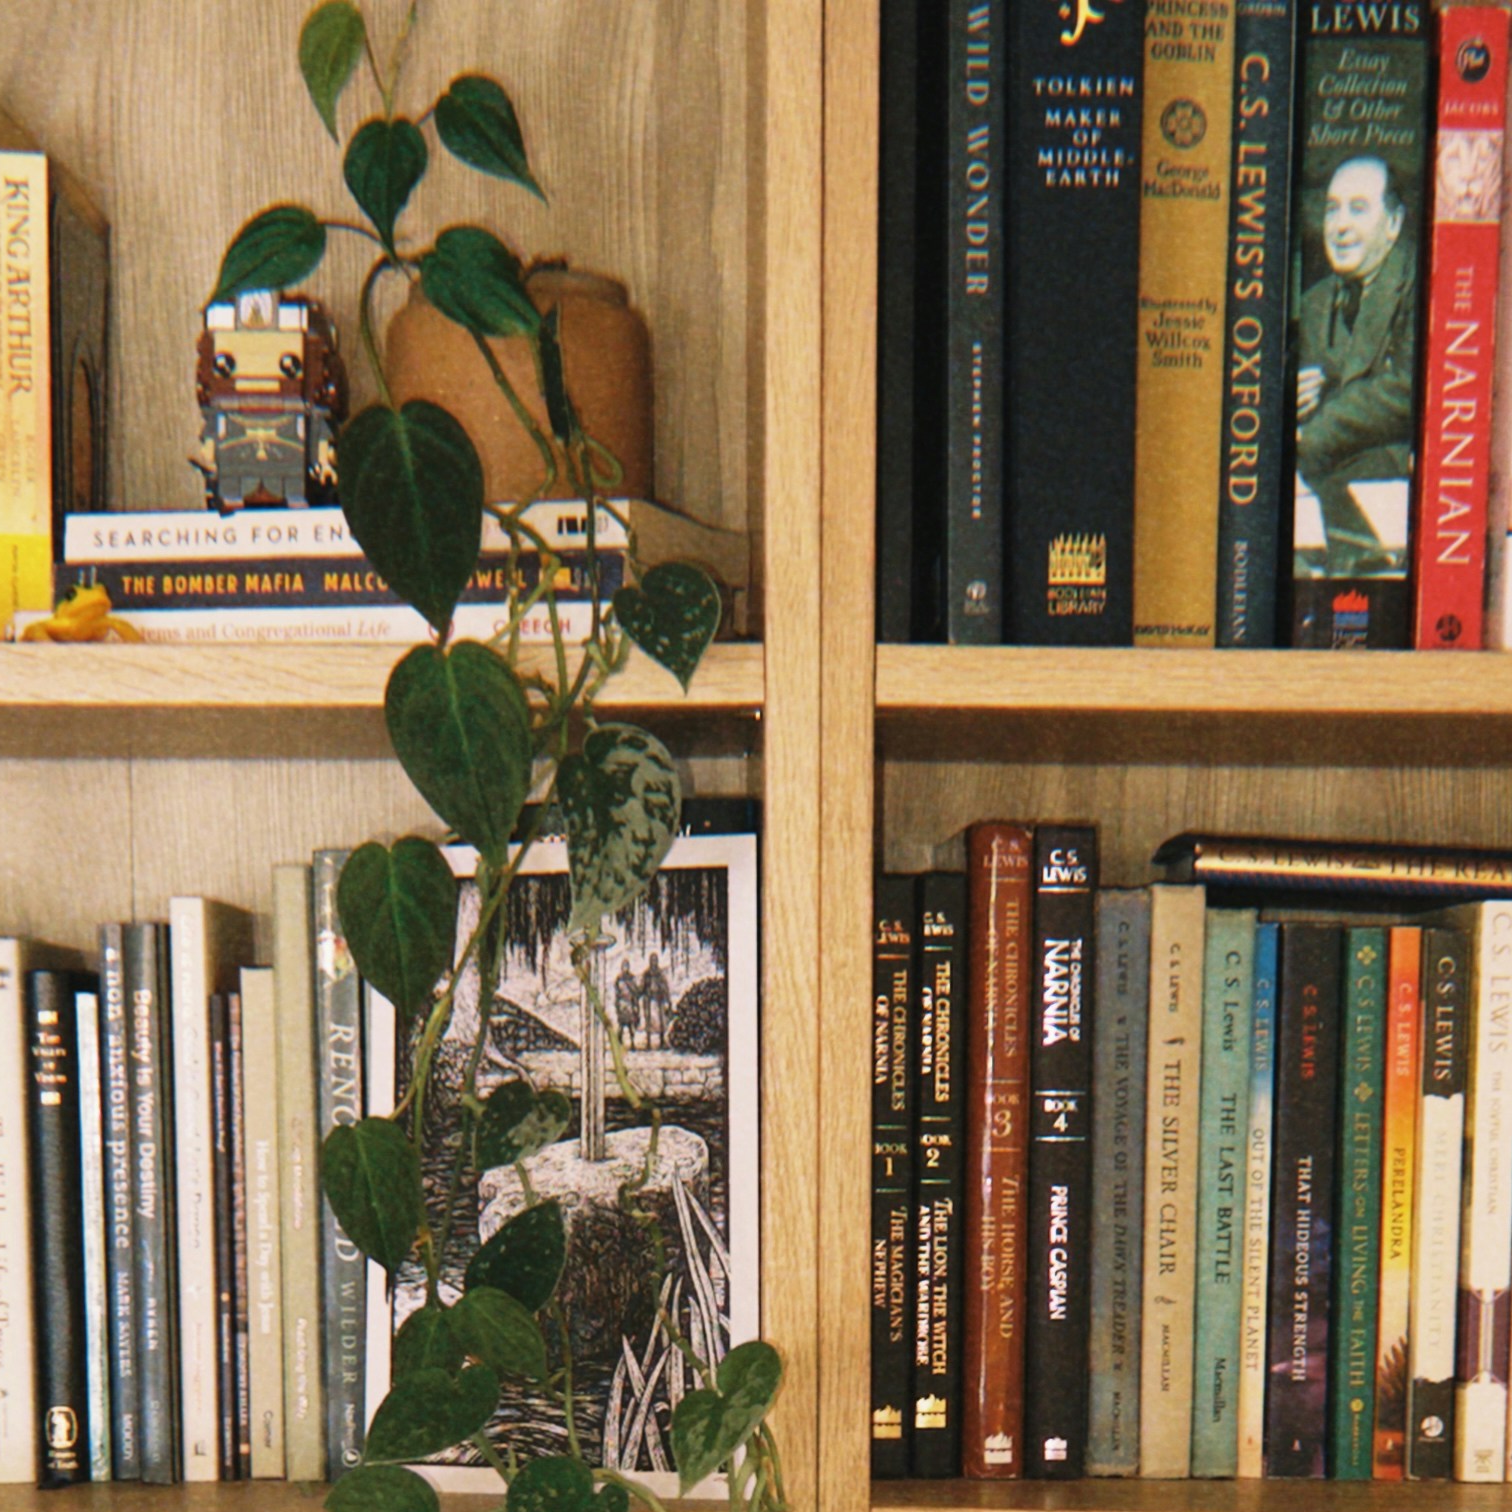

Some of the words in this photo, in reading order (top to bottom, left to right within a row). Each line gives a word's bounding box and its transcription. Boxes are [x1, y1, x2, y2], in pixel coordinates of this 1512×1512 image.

[1310, 5, 1420, 34] LEWIS
[965, 5, 990, 106] WILD
[1338, 51, 1389, 74] Essay
[1033, 77, 1135, 96] TOLKIEN
[1239, 51, 1271, 128] C.S.
[1318, 75, 1406, 97] Collection
[1324, 101, 1343, 120] &
[1351, 100, 1404, 120] Other
[1045, 110, 1121, 128] MAKER
[1072, 130, 1102, 145] OF
[1310, 126, 1355, 145] Short
[1361, 127, 1415, 145] Pieces
[1038, 150, 1135, 167] MIDDLE-
[1045, 170, 1120, 187] EARTH
[2, 175, 29, 258] KING
[965, 128, 990, 297] WONDER
[1235, 141, 1269, 301] LEWIS'S
[1454, 266, 1474, 310] THE
[5, 261, 34, 403] ARTHUR
[1229, 316, 1264, 506] OXFORD
[1437, 321, 1479, 565] NARNIAN
[94, 526, 236, 548] SEARCHING
[251, 525, 296, 544] FOR
[121, 575, 157, 596] THE
[163, 574, 238, 595] BOMBER
[245, 573, 304, 594] MAFIA
[1043, 938, 1070, 1046] NARNIA
[1162, 1058, 1182, 1107] THE
[1160, 1116, 1181, 1194] SILVER
[1250, 1128, 1265, 1165] OUT
[1250, 1169, 1264, 1190] OF
[1297, 1155, 1313, 1204] THAT
[1389, 1146, 1404, 1261] PERELANDRA
[1049, 1184, 1069, 1244] PRINCE
[1158, 1204, 1179, 1276] CHAIR
[1249, 1196, 1263, 1232] THE
[1247, 1237, 1263, 1299] SILENT
[1295, 1208, 1312, 1285] HIDEOUS
[1049, 1246, 1068, 1321] CASPIAN
[1244, 1305, 1261, 1373] PLANET
[1292, 1291, 1310, 1383] STRENGTH
